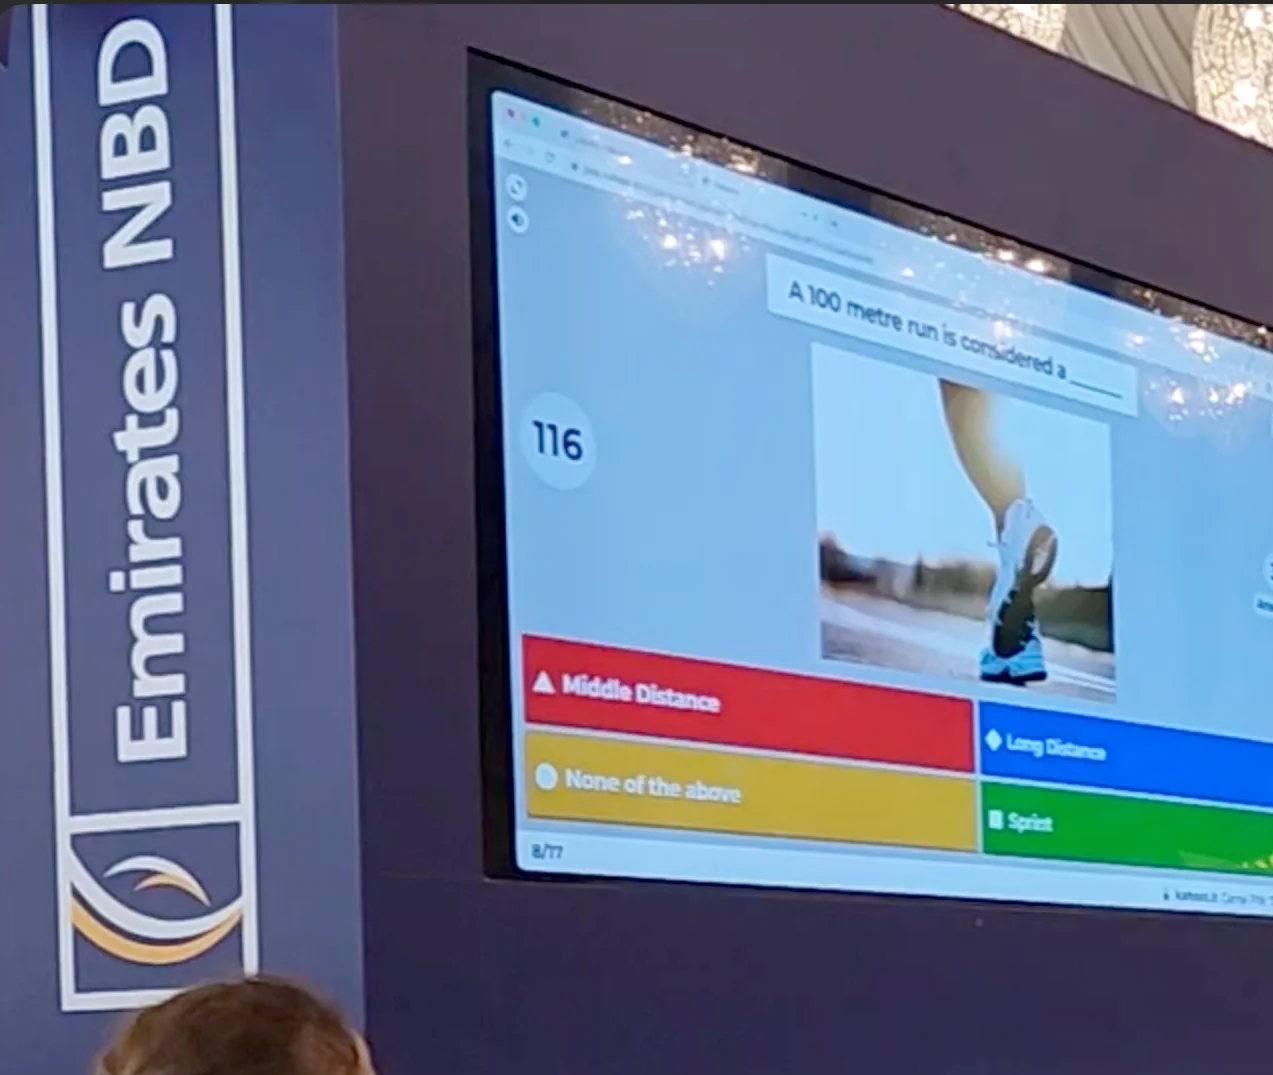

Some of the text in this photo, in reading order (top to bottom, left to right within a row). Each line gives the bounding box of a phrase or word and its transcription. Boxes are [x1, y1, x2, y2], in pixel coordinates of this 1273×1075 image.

[788, 279, 1068, 381] A 100 metre run is considered a
[97, 17, 189, 763] Emirates NBD
[531, 419, 584, 461] 116
[561, 673, 722, 714] Middle Distance
[1006, 732, 1107, 761] Long Distance
[565, 768, 743, 804] None of the above
[1007, 811, 1054, 835] Sprint
